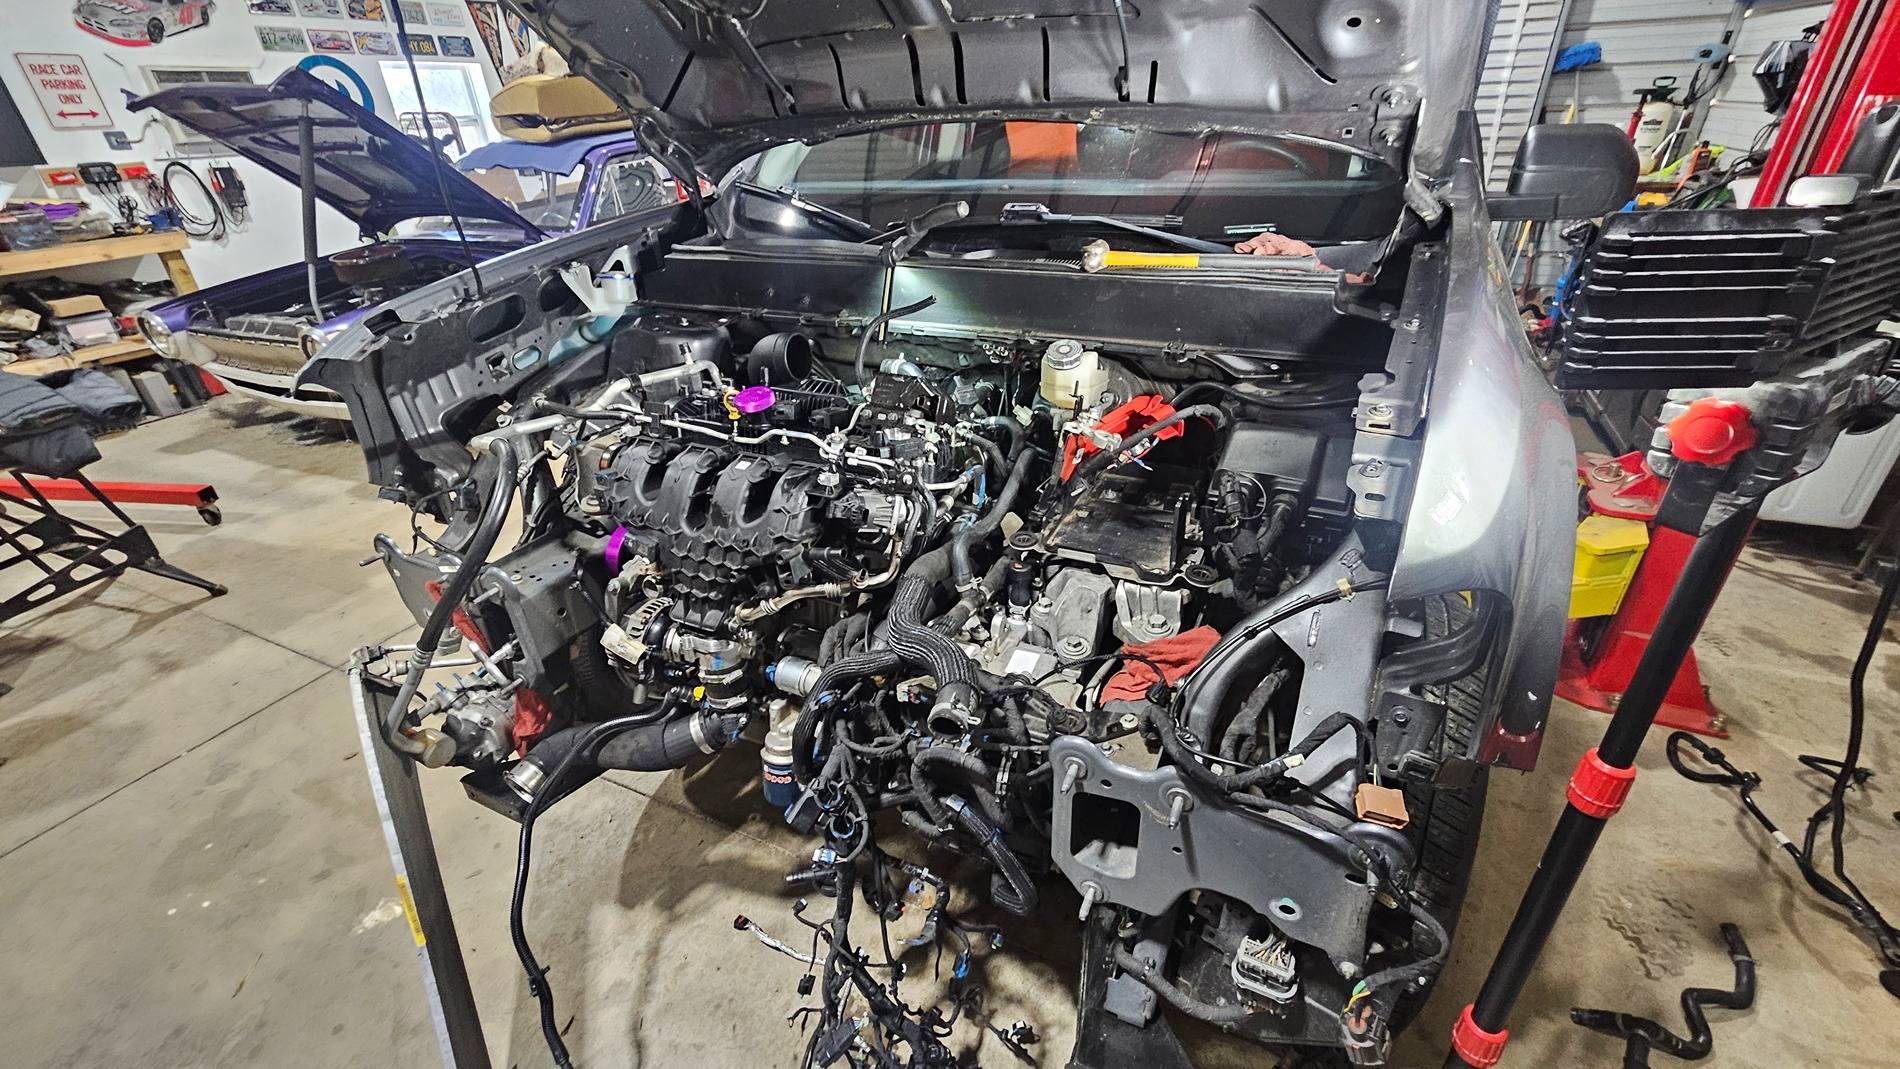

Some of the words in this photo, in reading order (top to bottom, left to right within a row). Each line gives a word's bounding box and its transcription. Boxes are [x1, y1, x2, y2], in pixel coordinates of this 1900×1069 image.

[29, 64, 59, 75] RACE
[60, 64, 82, 75] CAR
[40, 79, 87, 90] PARKING
[58, 94, 83, 105] ONLY
